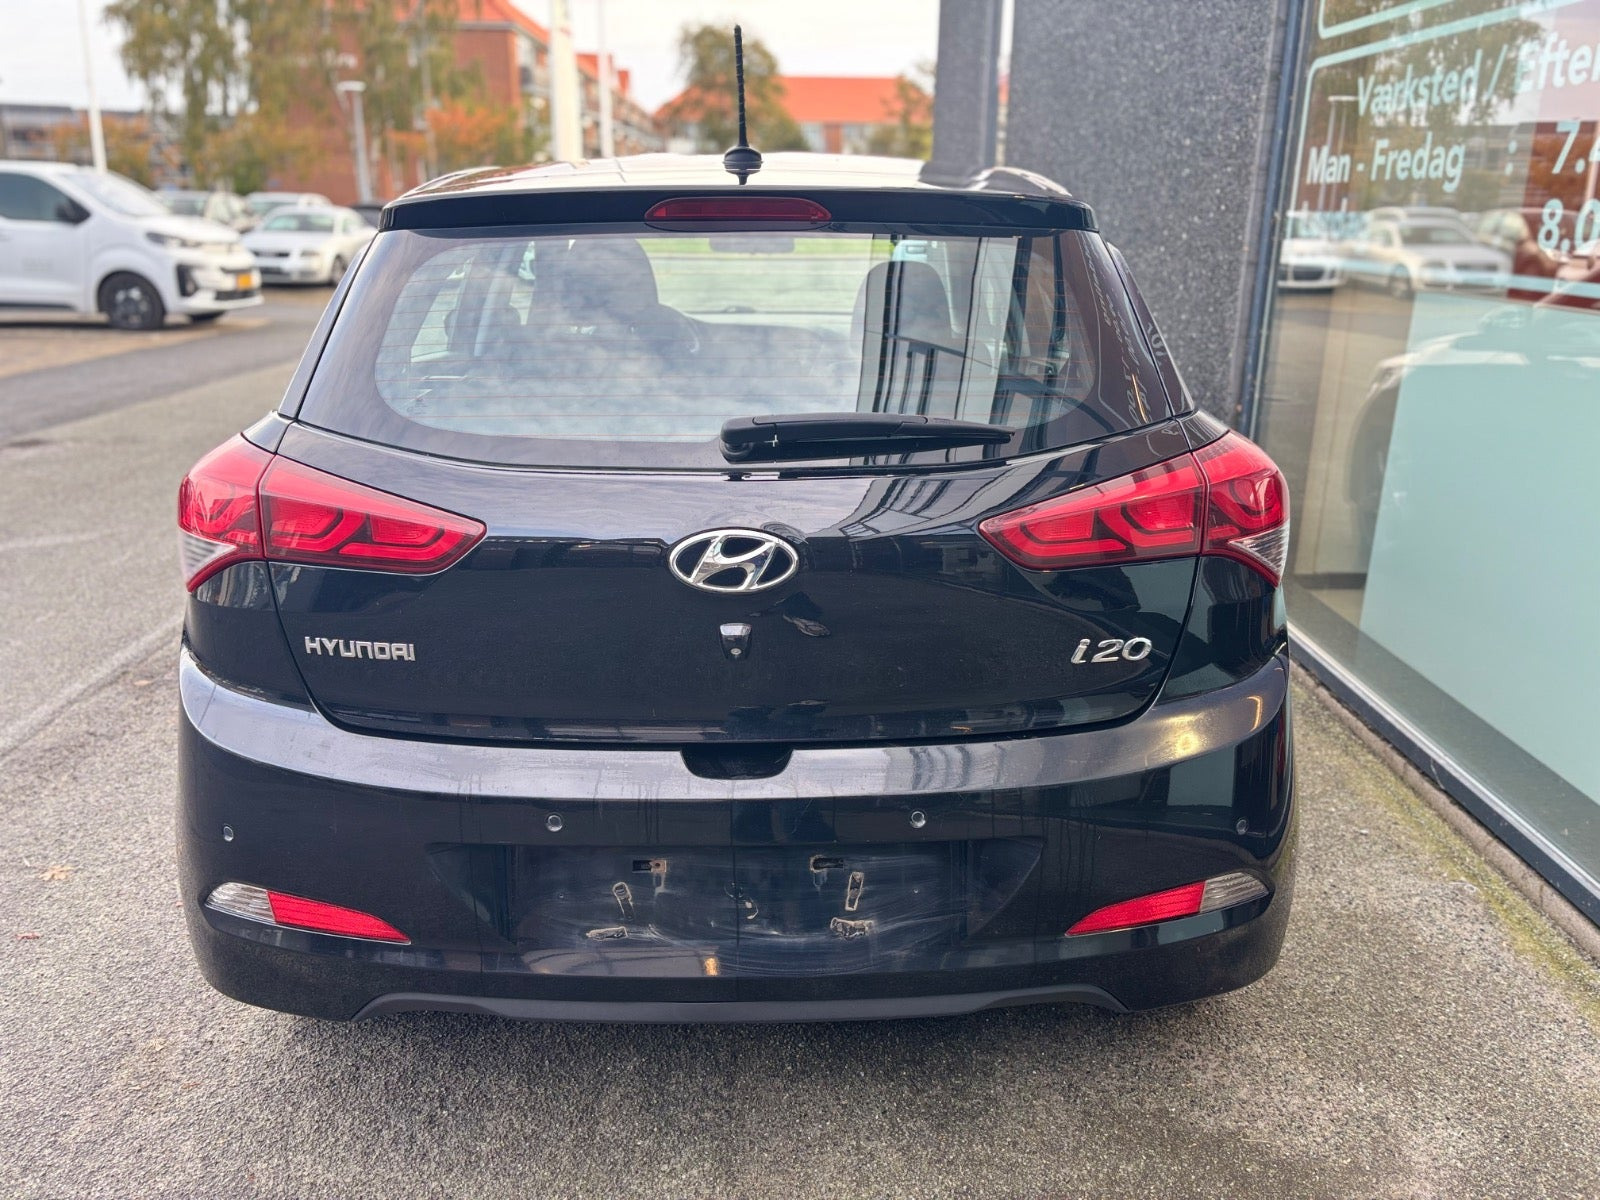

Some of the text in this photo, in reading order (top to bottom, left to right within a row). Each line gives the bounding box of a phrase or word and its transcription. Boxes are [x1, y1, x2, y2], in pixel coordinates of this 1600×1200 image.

[1358, 48, 1482, 117] Værksted
[1306, 145, 1350, 184] Man
[1370, 131, 1465, 193] Fredag
[304, 636, 416, 661] HYUNDAI
[1071, 637, 1152, 664] i20
